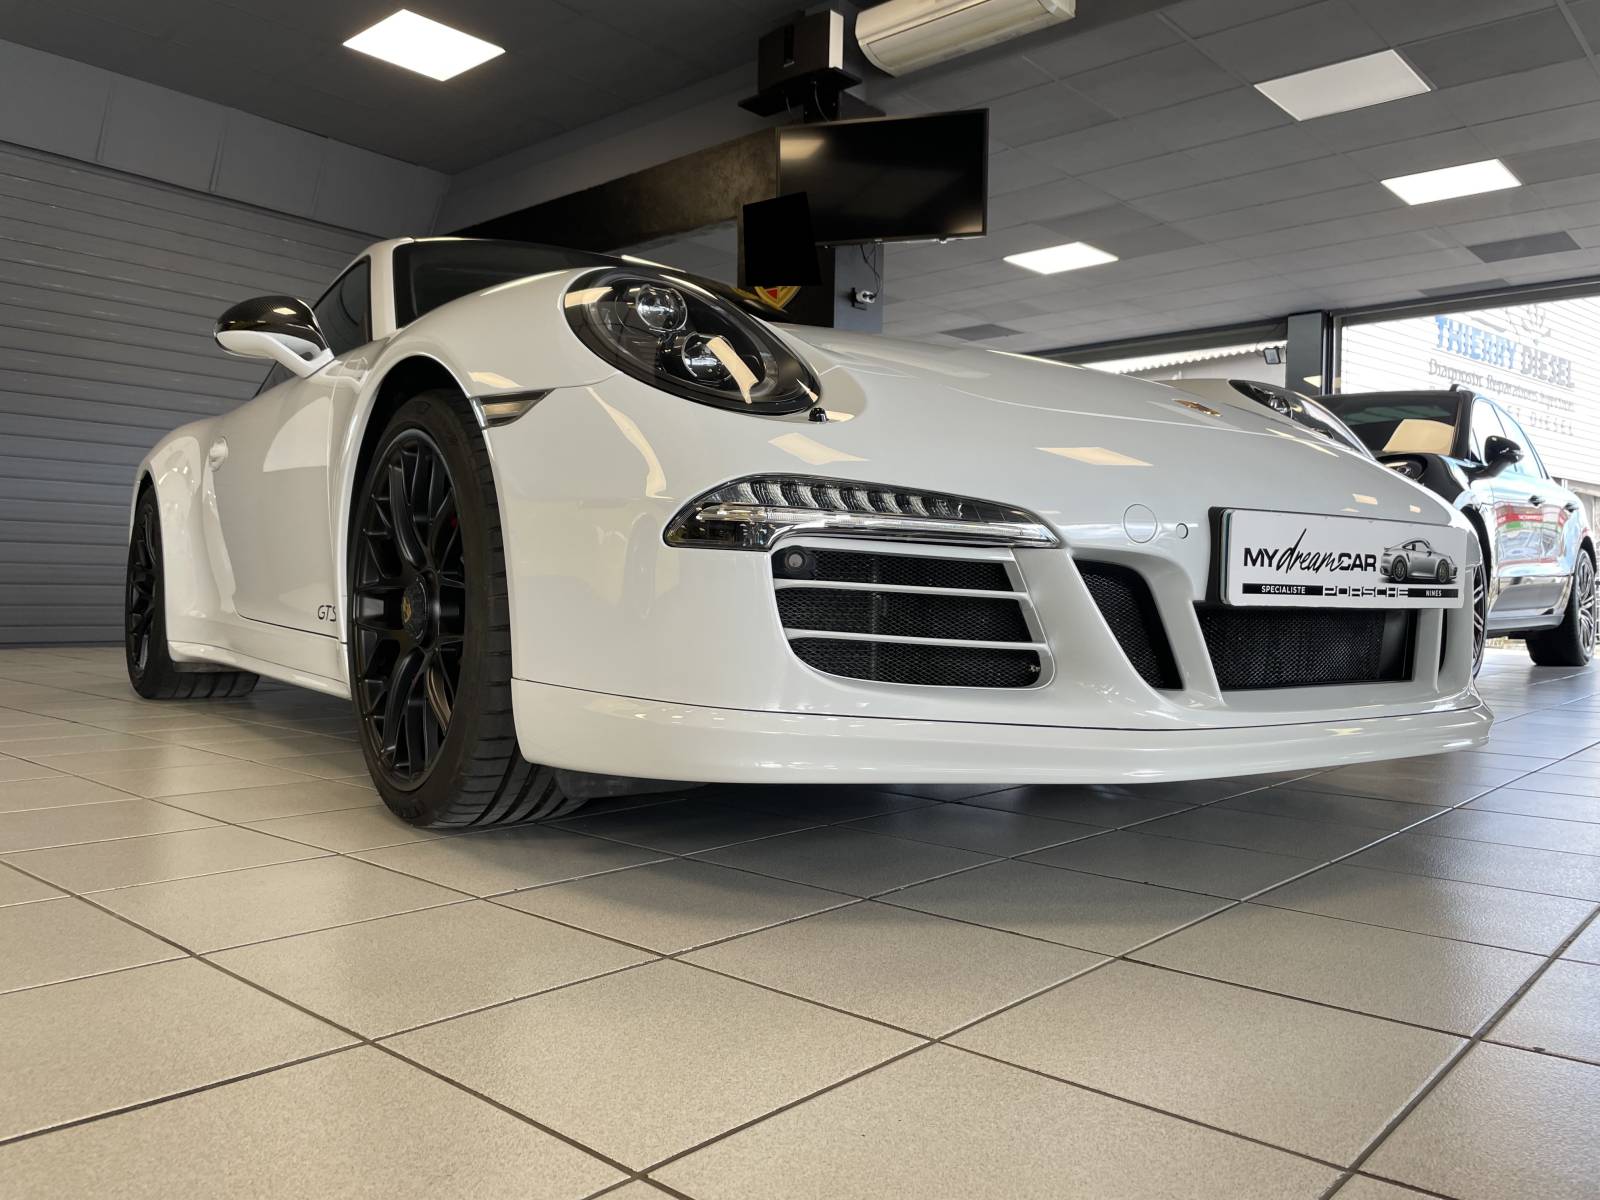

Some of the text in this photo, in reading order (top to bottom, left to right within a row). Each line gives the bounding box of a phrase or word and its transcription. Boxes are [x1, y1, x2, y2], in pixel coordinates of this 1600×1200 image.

[1435, 314, 1575, 388] THIERRY DIESEL
[1244, 528, 1377, 574] MY dream CAR
[1261, 585, 1442, 598] SPECIALISTE PORSCHE NIMES
[317, 604, 337, 622] GTS
